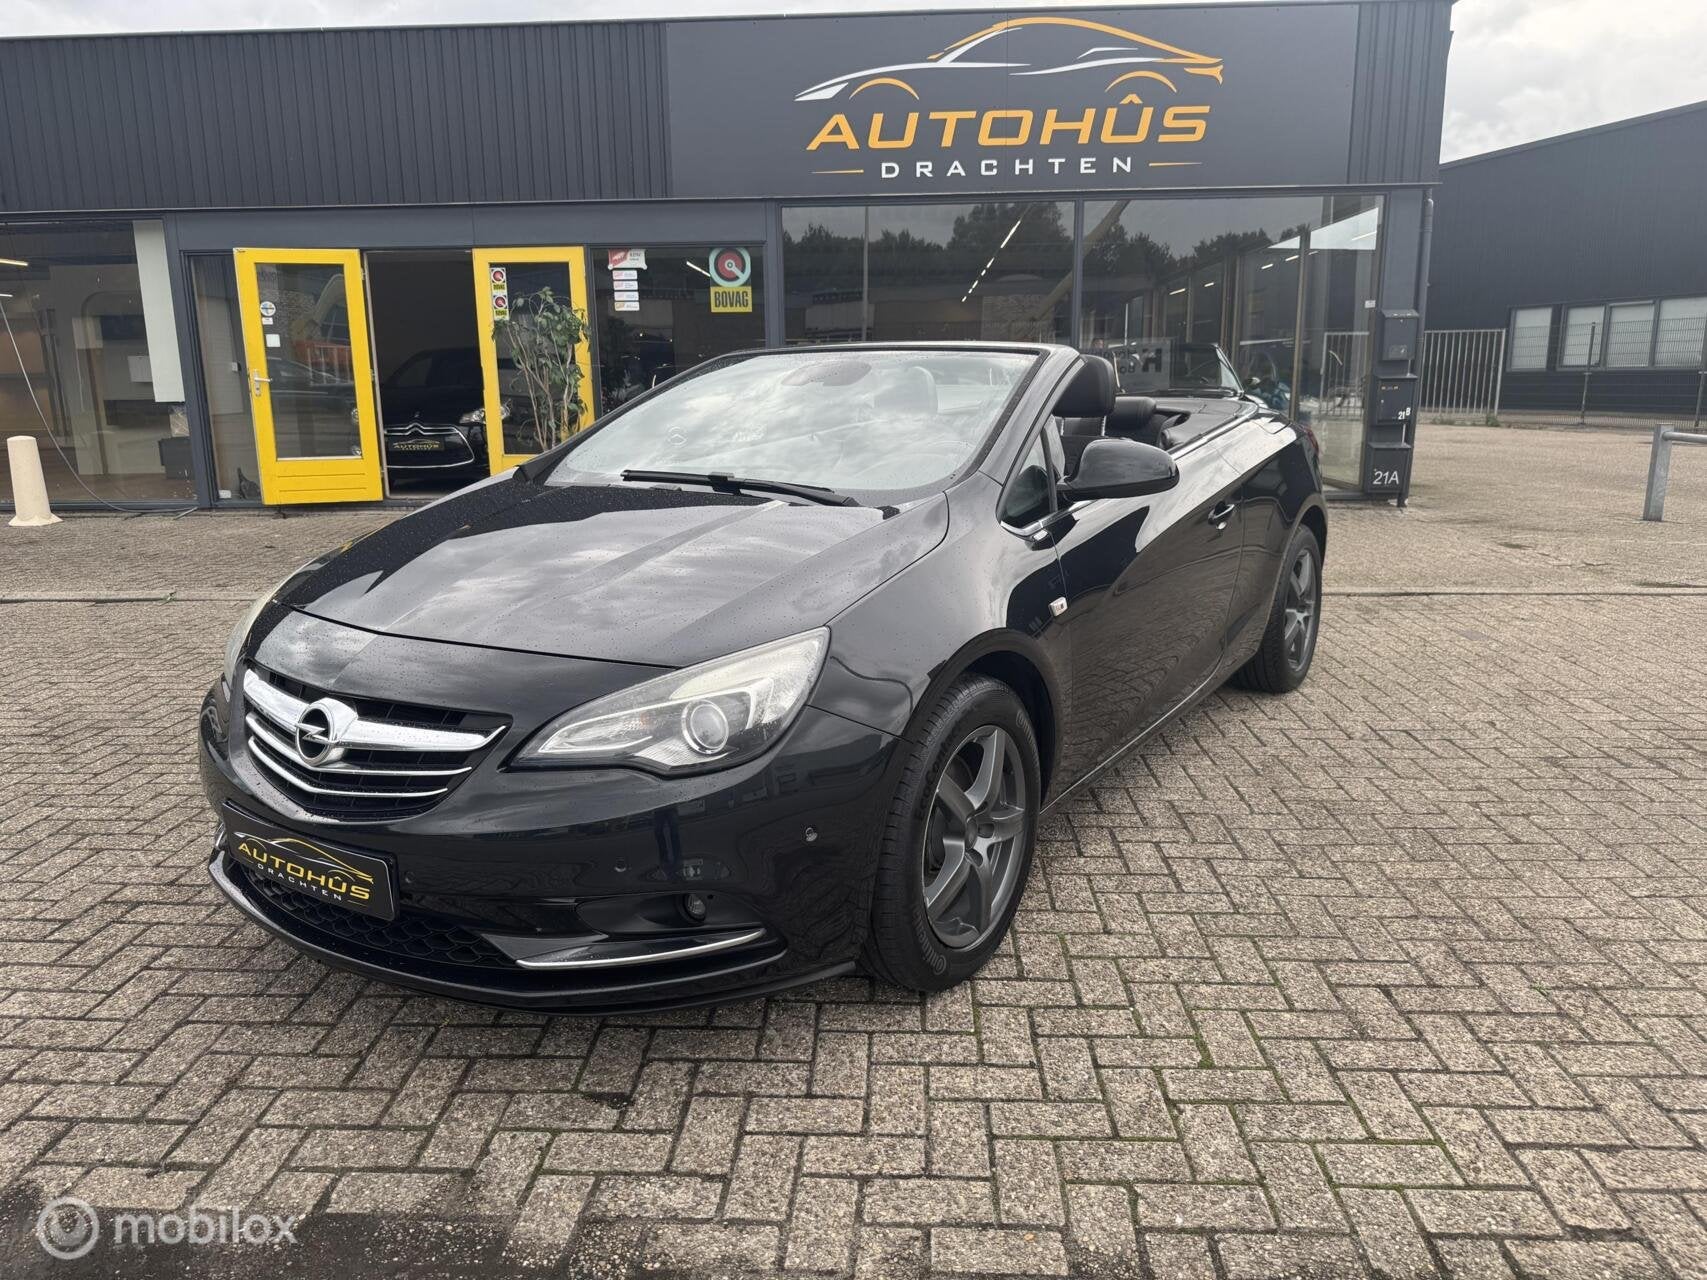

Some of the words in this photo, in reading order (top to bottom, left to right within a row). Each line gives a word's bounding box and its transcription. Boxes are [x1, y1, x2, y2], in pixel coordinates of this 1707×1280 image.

[806, 93, 1211, 151] AUTOHÛS
[880, 156, 1133, 179] DRACHTEN
[714, 290, 749, 308] BOVAG
[1372, 470, 1400, 485] 21A
[237, 842, 370, 901] AUTOHÛS
[257, 863, 342, 901] DRACHTEN
